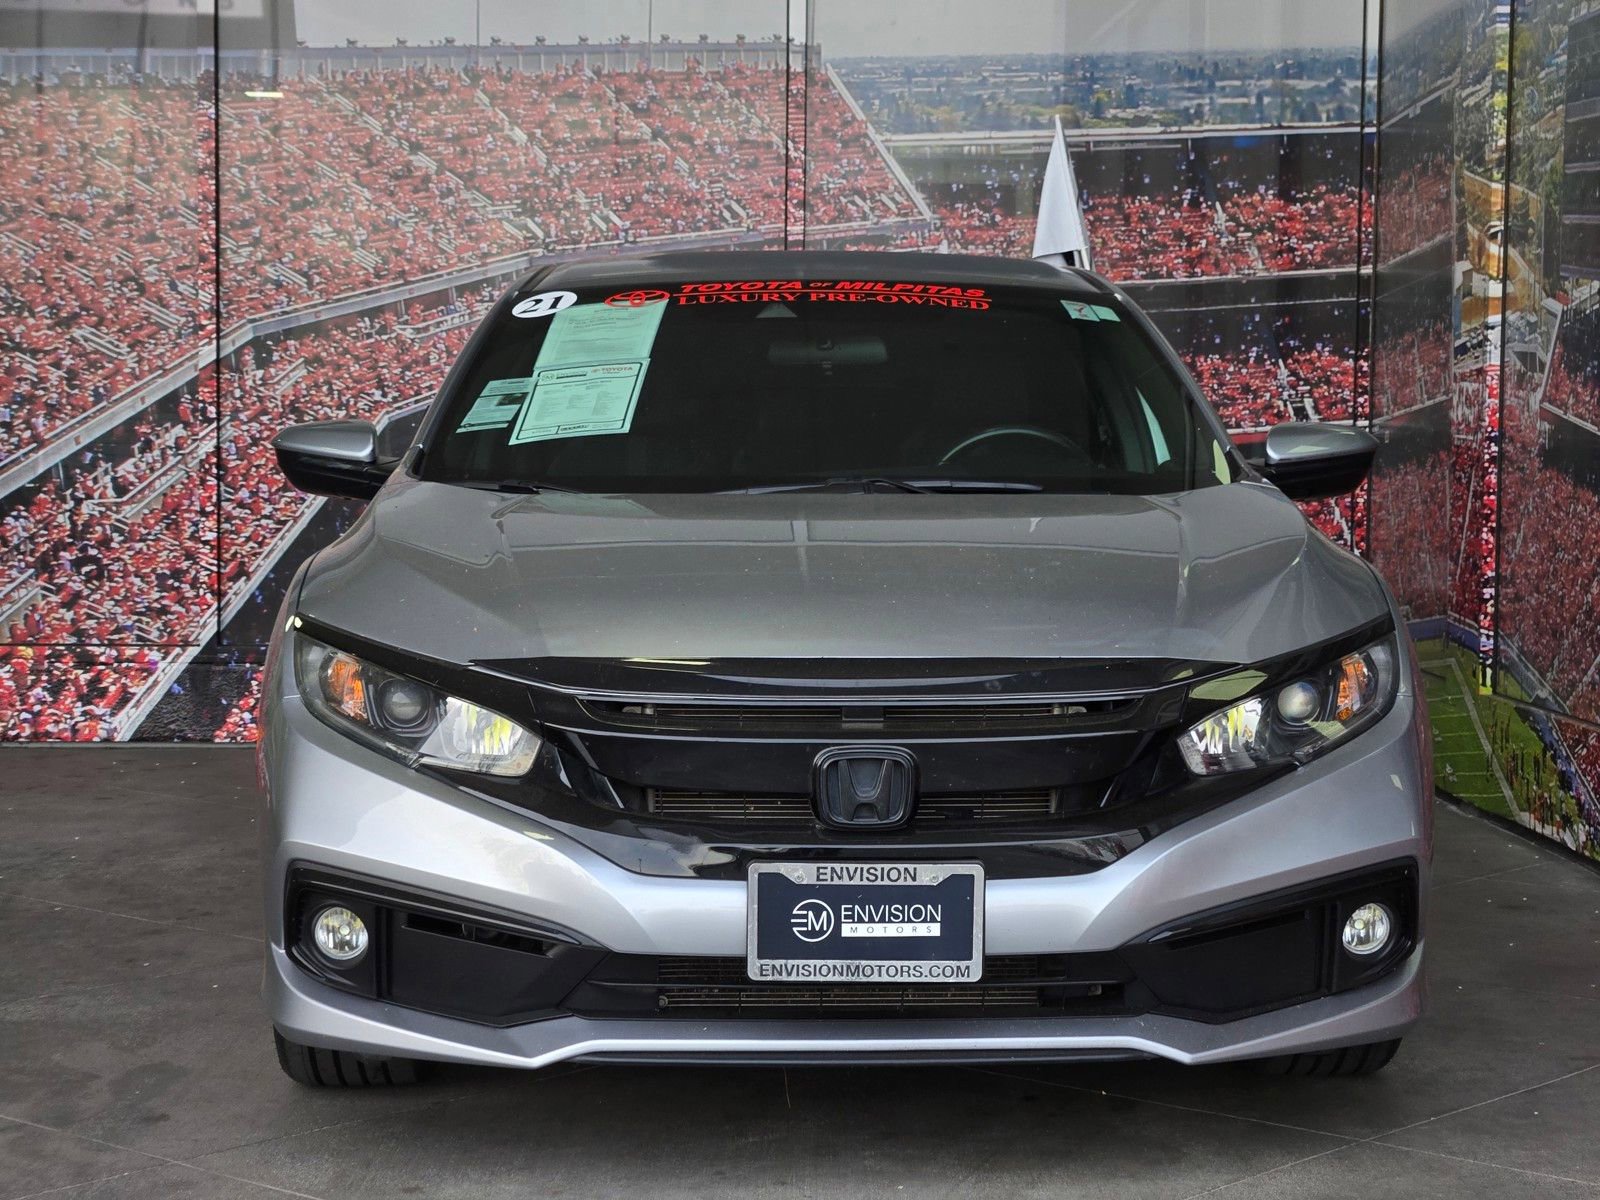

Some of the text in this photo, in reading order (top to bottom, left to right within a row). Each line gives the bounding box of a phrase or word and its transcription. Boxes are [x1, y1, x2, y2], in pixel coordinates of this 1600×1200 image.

[681, 281, 802, 293] TOYOTA
[835, 281, 985, 297] MILPITAS
[515, 295, 565, 315] 21
[677, 293, 990, 310] LUXURY PRE-OWNED
[815, 866, 918, 883] ENVISION
[841, 904, 942, 922] ENVISION
[850, 926, 932, 934] MOTORS
[759, 963, 971, 979] ENVISIONMOTORS.COM
